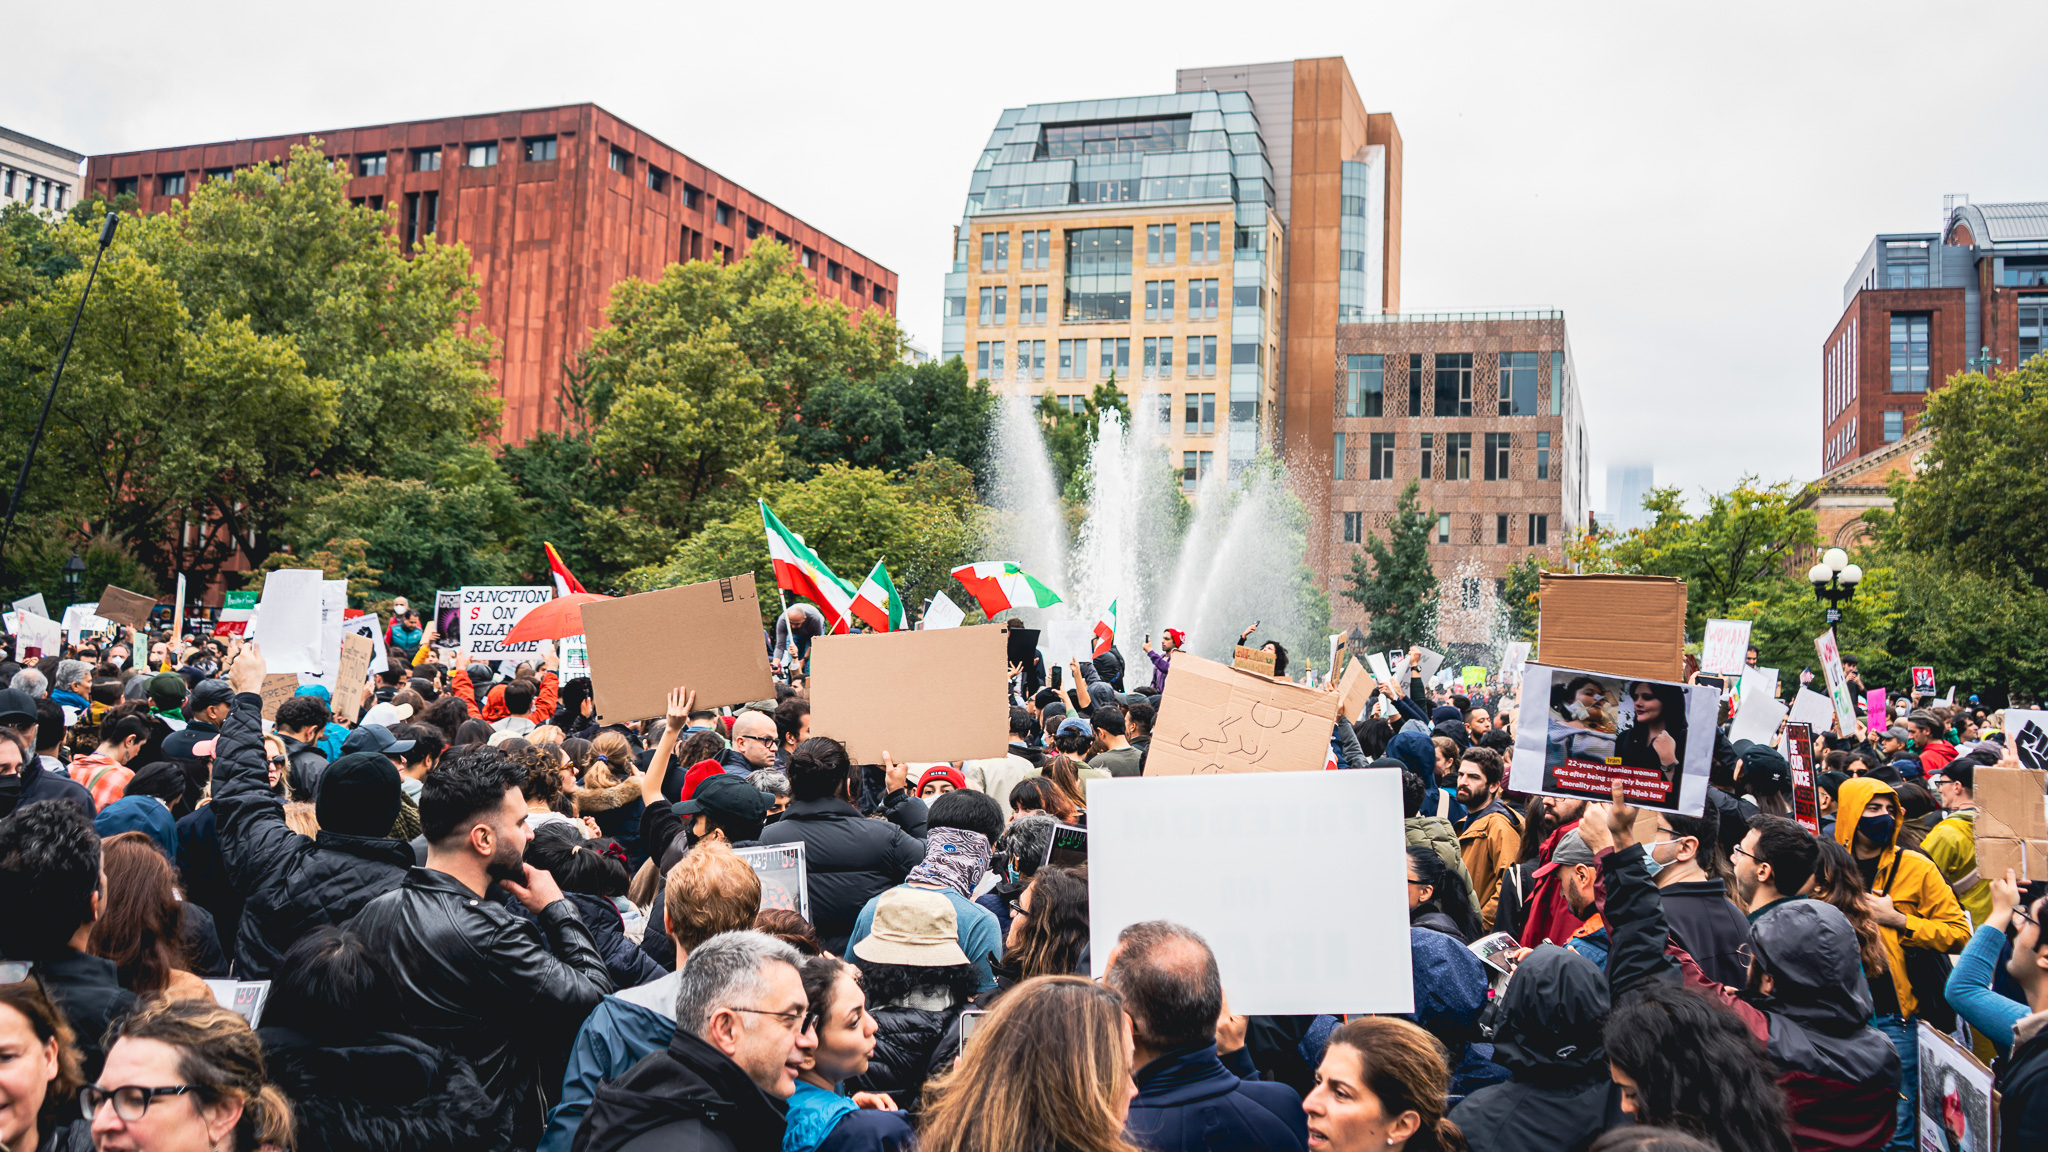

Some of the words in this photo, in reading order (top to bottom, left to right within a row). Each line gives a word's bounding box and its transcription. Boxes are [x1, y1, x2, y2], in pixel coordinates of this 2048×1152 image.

[464, 590, 550, 604] SANCTION
[470, 606, 480, 620] S
[492, 606, 518, 620] ON
[1708, 627, 1748, 645] WOMAN
[470, 640, 540, 653] REGIME
[1789, 739, 1799, 754] BE
[1567, 759, 1607, 771] 22-year-old
[1607, 766, 1633, 775] Iranian
[1633, 770, 1659, 778] woman
[1791, 755, 1804, 770] OUR
[1554, 768, 1569, 776] dies
[1569, 771, 1587, 779] after
[1587, 772, 1606, 782] being
[1607, 777, 1635, 786] serely
[1635, 779, 1660, 789] beaten
[1660, 782, 1670, 791] by
[1793, 770, 1811, 787] VOICE
[1631, 789, 1649, 798] hijab
[1649, 791, 1664, 800] law
